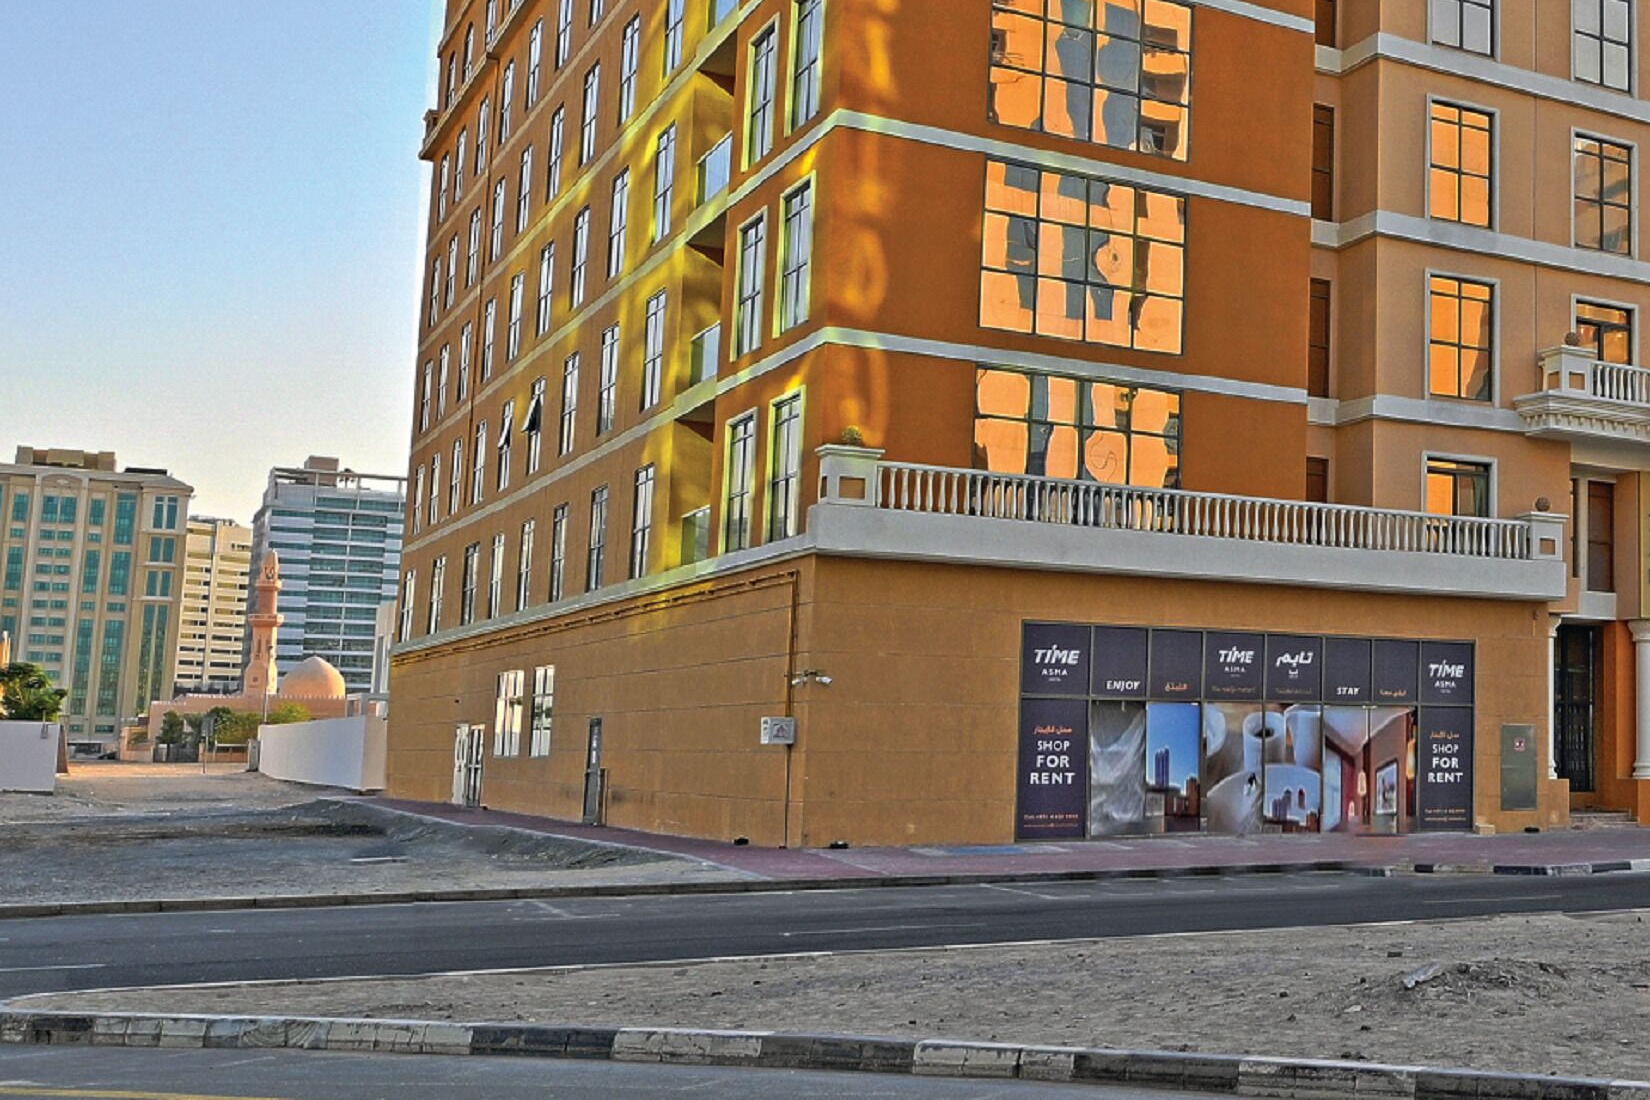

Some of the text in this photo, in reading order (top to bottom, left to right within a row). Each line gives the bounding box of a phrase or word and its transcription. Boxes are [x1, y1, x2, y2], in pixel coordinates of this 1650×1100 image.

[1033, 644, 1080, 665] TIME
[1218, 645, 1255, 664] TIME
[1428, 659, 1465, 678] TIME
[1106, 680, 1140, 692] ENJOY
[1336, 686, 1361, 696] STAY
[1037, 740, 1070, 751] SHOP
[1432, 743, 1459, 754] SHOP
[1036, 755, 1070, 768] FOR
[1432, 757, 1459, 769] FOR
[1029, 772, 1076, 785] RENT
[1427, 772, 1463, 783] RENT
